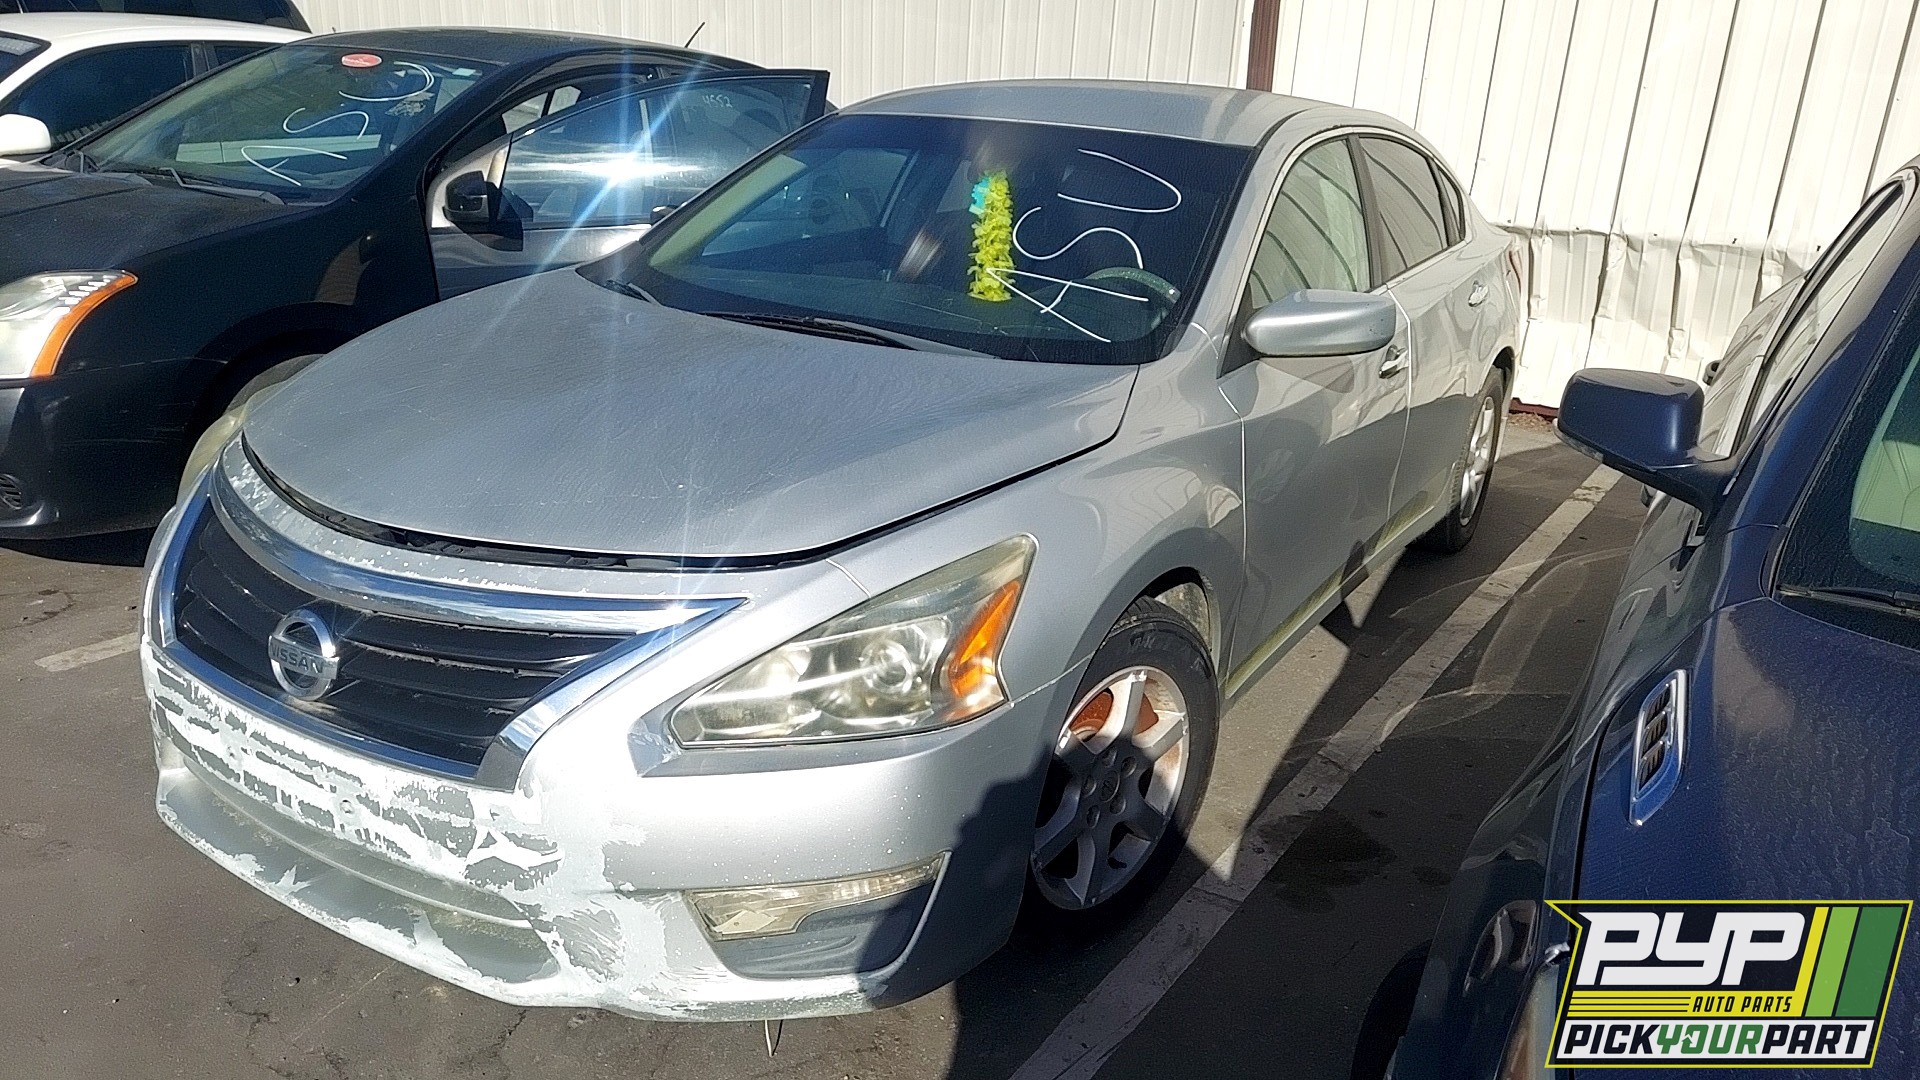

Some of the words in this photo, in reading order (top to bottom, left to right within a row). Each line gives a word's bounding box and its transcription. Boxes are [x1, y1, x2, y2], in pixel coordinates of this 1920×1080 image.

[241, 61, 435, 187] ASU
[986, 148, 1182, 343] ASU
[271, 642, 324, 674] NISSAN
